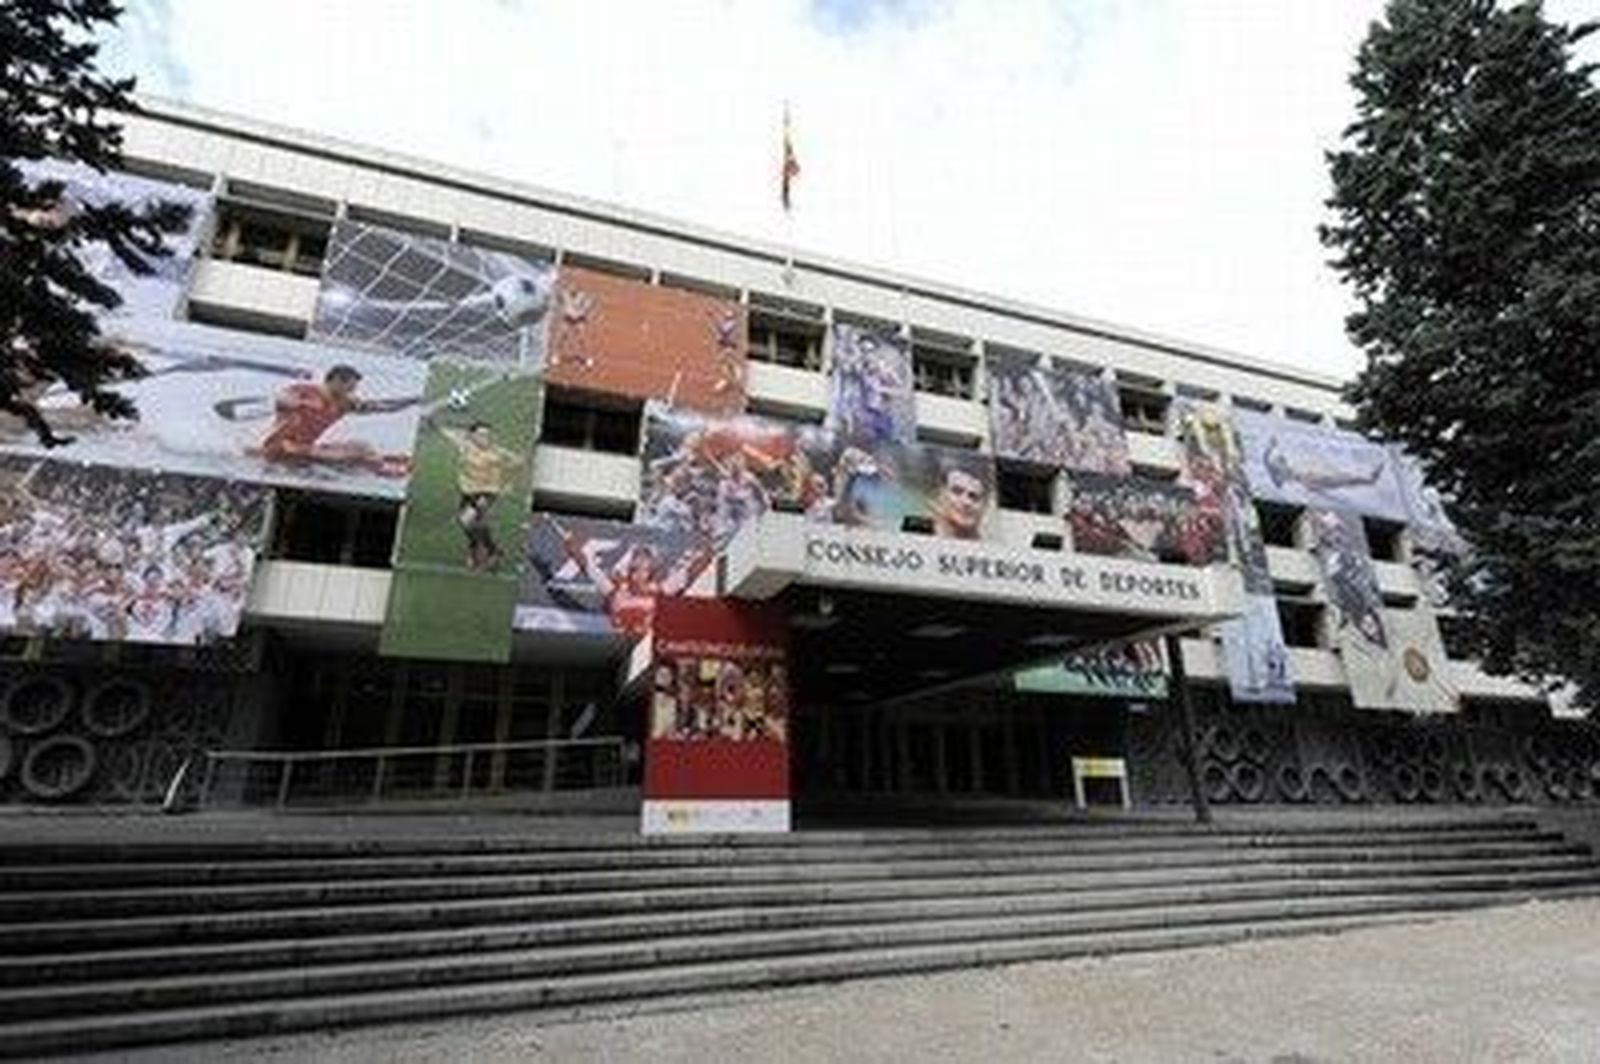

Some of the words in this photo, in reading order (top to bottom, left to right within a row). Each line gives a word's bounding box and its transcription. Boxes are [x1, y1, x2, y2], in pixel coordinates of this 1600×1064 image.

[807, 540, 923, 571] CONSEJO
[938, 556, 1046, 585] SUPERIOR
[1062, 567, 1088, 588] DE
[1100, 572, 1200, 599] DEPORTES
